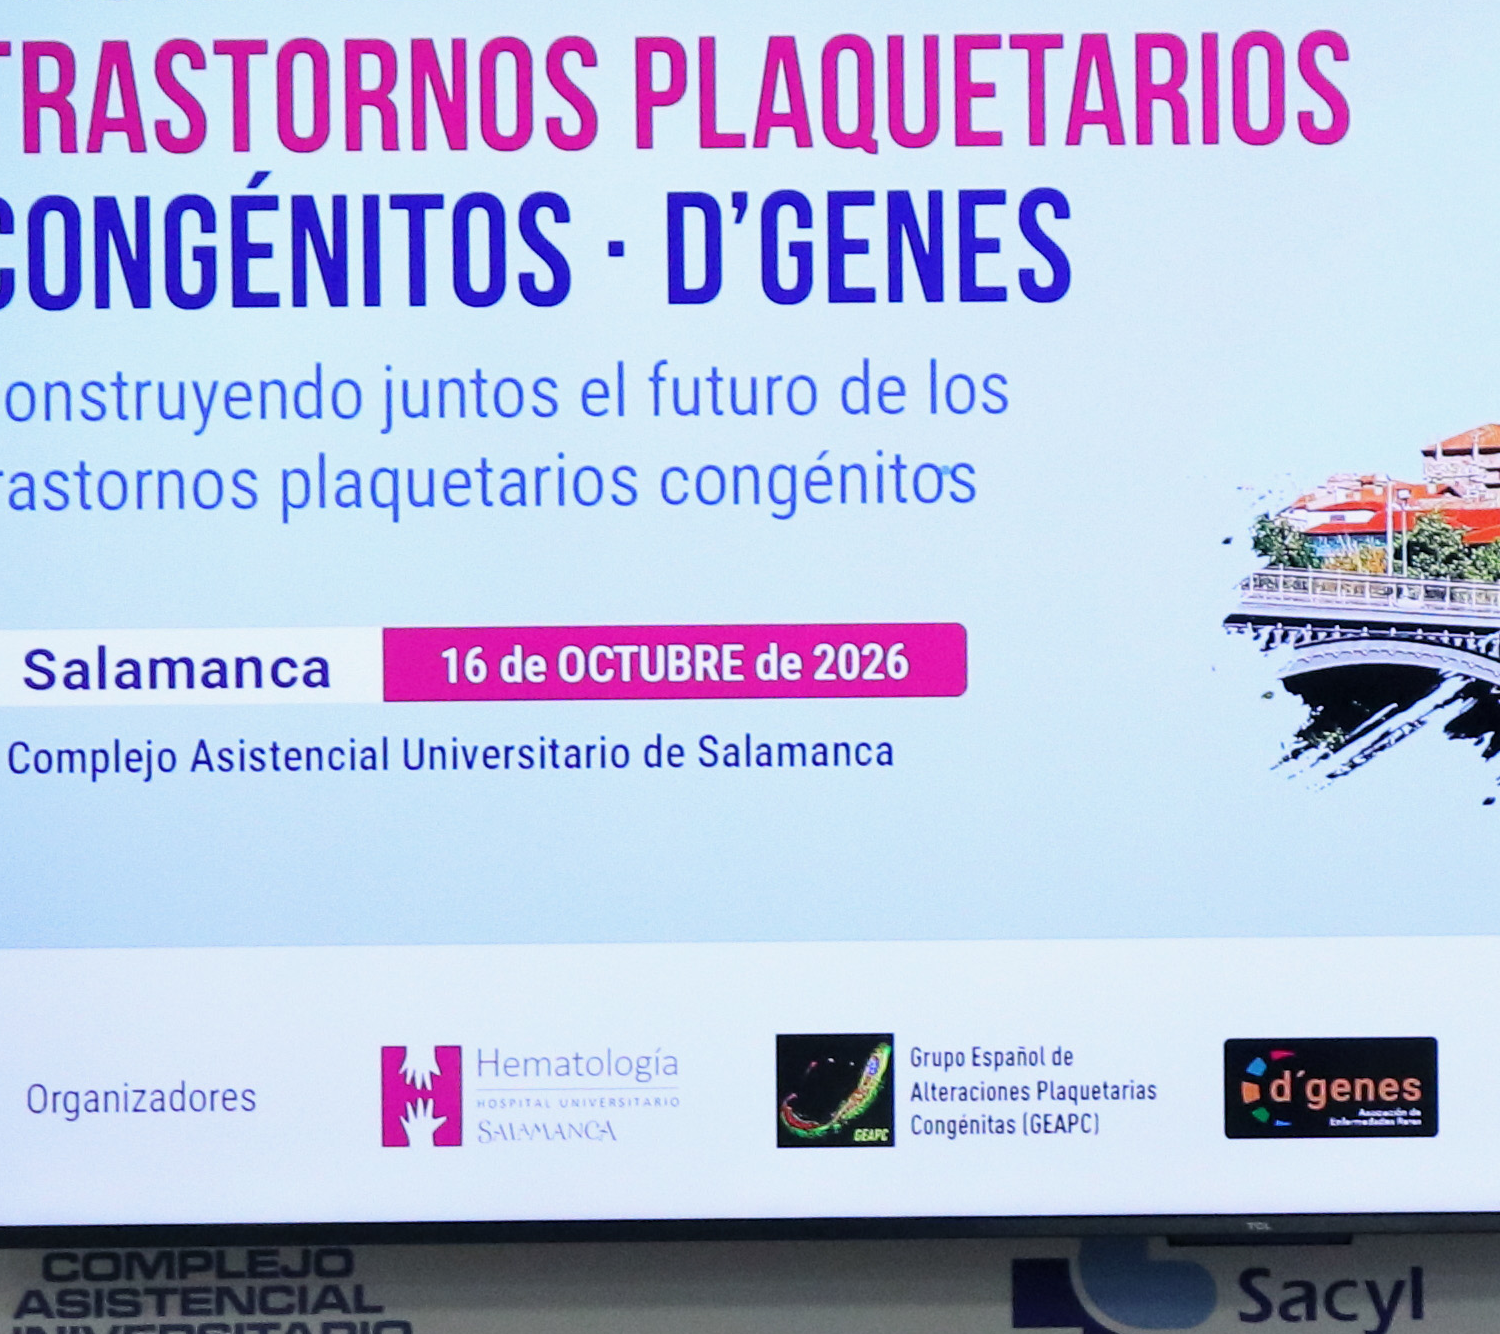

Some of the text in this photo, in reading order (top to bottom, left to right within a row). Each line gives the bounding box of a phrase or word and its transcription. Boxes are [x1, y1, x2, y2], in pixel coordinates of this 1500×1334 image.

[635, 30, 1350, 155] PLAQUETARIOS
[381, 365, 558, 434] juntos
[582, 361, 624, 417] el
[649, 360, 817, 416] futuro
[842, 358, 905, 415] de
[930, 359, 1008, 414] los
[282, 452, 637, 524] plaquetarios
[661, 450, 975, 520] congénitos
[24, 645, 329, 690] Salamanca
[442, 643, 908, 683] 16 de OCTUBRE de 2026
[8, 734, 893, 782] Complejo Asistencial Universitario de Salamanca
[478, 1048, 678, 1083] Hematología
[911, 1046, 1073, 1072] Grupo Español de
[27, 1081, 256, 1122] Organizadores
[477, 1097, 679, 1109] HOSPITAL UNIVERSITARIO
[911, 1080, 1156, 1105] Alteraciones Plaquetarias
[854, 1129, 889, 1141] GEAPC
[911, 1113, 1098, 1140] Congénitas (GEAPC)
[42, 1248, 355, 1283] COMPLEJO
[14, 1284, 385, 1320] ASISTENCIAL
